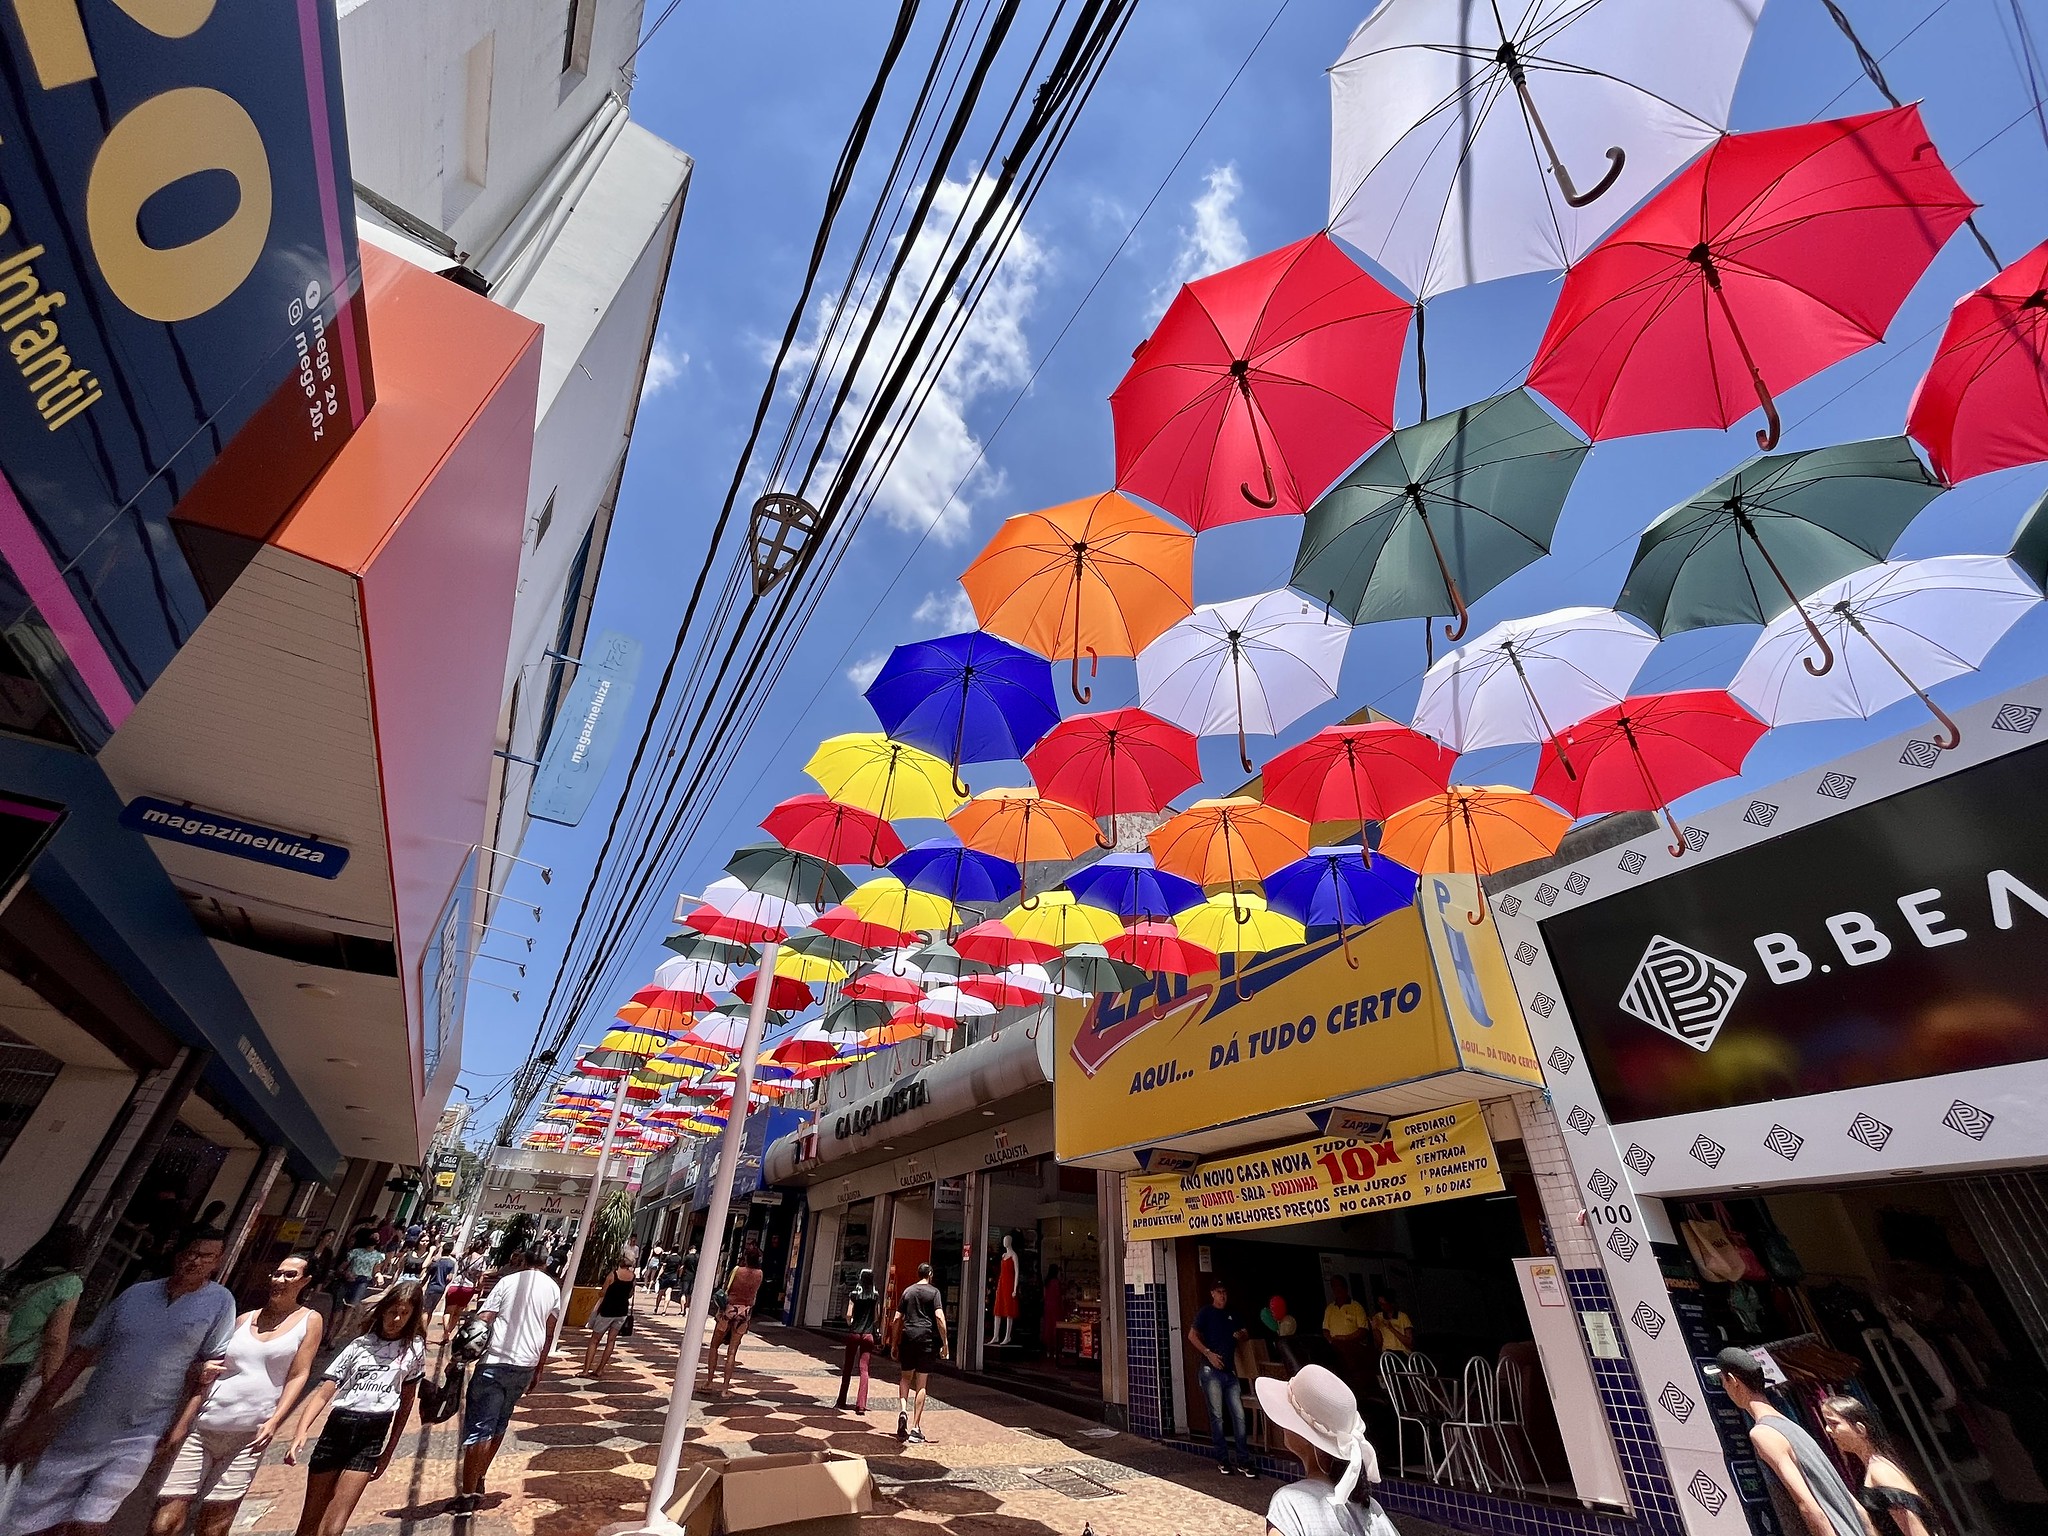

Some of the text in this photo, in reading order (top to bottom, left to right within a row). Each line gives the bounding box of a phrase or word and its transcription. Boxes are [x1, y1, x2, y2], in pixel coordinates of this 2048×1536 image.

[0, 244, 103, 432] Infantil
[312, 315, 338, 416] mega 20
[295, 331, 325, 441] mega 20z
[571, 680, 611, 763] magazineluiza
[142, 809, 325, 863] magazineluiza
[1129, 981, 1422, 1095] AQUI... DÁ TUDO CERTO
[1486, 1045, 1496, 1059] DÁ
[1499, 1050, 1517, 1065] TUDO
[1518, 1055, 1539, 1071] CERTO
[835, 1079, 931, 1139] CALÇADISTA
[1342, 1119, 1370, 1132] ZAPP
[1313, 1139, 1358, 1155] TUDO
[1410, 1133, 1448, 1150] ATÉ 24X
[984, 1144, 1029, 1165] CALÇADISTA
[1158, 1157, 1185, 1168] ZAPP
[1317, 1140, 1402, 1185] 10X
[1415, 1145, 1466, 1165] S/ENTRADA
[900, 1171, 932, 1187] CALÇADISTA
[1180, 1152, 1312, 1192] ANO NOVO CASA NOVA
[1430, 1157, 1488, 1178] PAGAMENTO
[1200, 1189, 1235, 1208] QUARTO
[1241, 1185, 1266, 1202] SALA
[1271, 1175, 1318, 1197] COZINHA
[1333, 1174, 1407, 1197] SEM JUROS
[1436, 1182, 1447, 1193] 60
[1450, 1178, 1471, 1191] DIAS
[1340, 1189, 1412, 1212] NO CARTÃO
[1133, 1208, 1185, 1229] APROVEITEM!
[1188, 1198, 1330, 1230] COM OS MELHORES PREÇOS
[1591, 1204, 1632, 1225] 100
